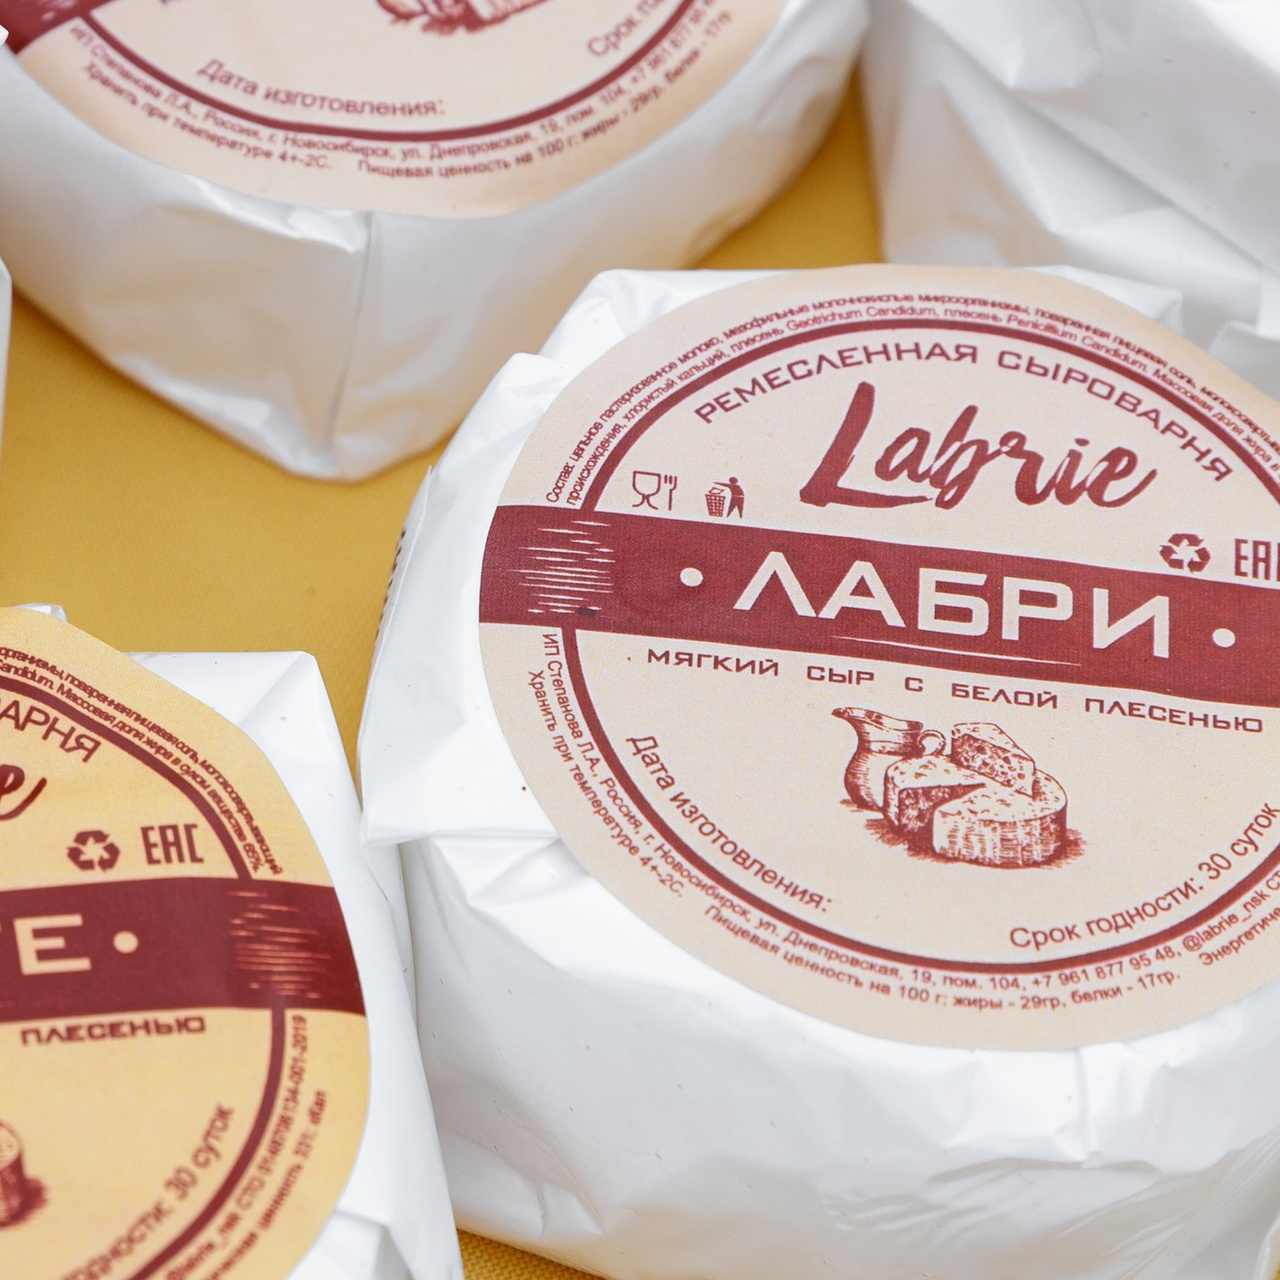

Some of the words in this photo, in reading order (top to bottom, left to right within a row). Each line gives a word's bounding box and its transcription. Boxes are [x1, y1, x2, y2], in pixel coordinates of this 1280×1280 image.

[586, 16, 637, 58] Срок
[196, 57, 259, 98] Дата
[262, 85, 446, 117] изготовления:
[694, 341, 978, 424] РЕМЕСЛЕННАЯ
[996, 349, 1234, 483] СЫРОВАРНЯ
[799, 381, 1159, 510] Labrie
[733, 550, 1170, 659] ЛАБРИ
[543, 632, 559, 658] ИП
[545, 657, 585, 742] Степанова
[647, 647, 780, 677] МЯГКИЙ
[806, 665, 875, 686] СЫР
[904, 675, 925, 693] С
[951, 682, 1059, 710] БЕЛОЙ
[1084, 697, 1264, 734] ПЛЕСЕНЬЮ
[527, 669, 557, 734] Хранить
[552, 730, 574, 765] при
[568, 759, 641, 857] температуре
[704, 903, 781, 956] Пищевая
[782, 945, 865, 990] ценность
[868, 978, 891, 995] на
[898, 984, 930, 1004] 100
[1070, 985, 1124, 1005] белки
[599, 778, 644, 837] Россия,
[625, 735, 677, 792] Дата
[668, 789, 833, 913] изготовления:
[652, 843, 753, 923] Новосибирск,
[1009, 923, 1083, 951] Срок
[1084, 875, 1205, 936] годности:
[1197, 852, 1233, 882] 30
[756, 917, 780, 939] ул.
[1181, 890, 1271, 952] @labrie_nsk
[782, 929, 904, 979] Днепровская,
[941, 976, 983, 990] пом.
[1031, 973, 1052, 989] +7
[1058, 968, 1090, 987] 961
[1094, 958, 1125, 981] 877
[1129, 953, 1153, 971] 95
[20, 1015, 207, 1046] ПЛЕСЕНЬЮ
[163, 1165, 199, 1201] 30
[191, 1101, 234, 1170] суток
